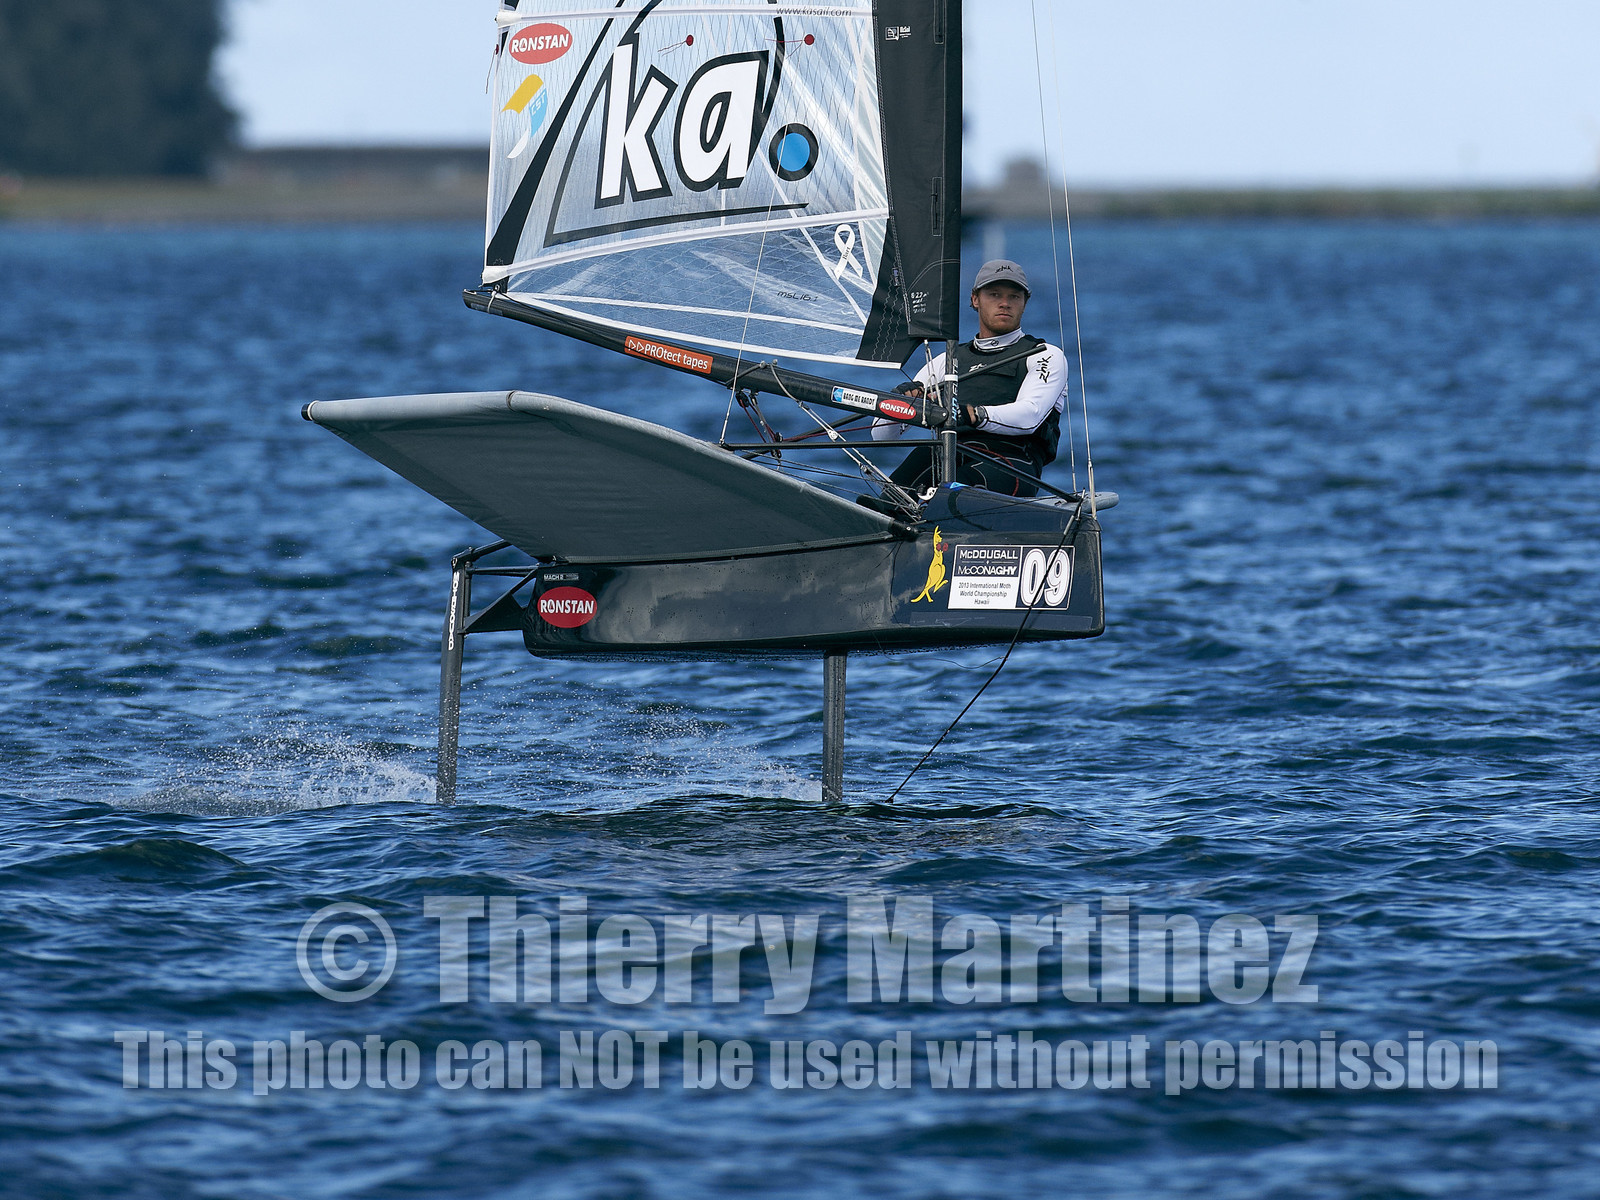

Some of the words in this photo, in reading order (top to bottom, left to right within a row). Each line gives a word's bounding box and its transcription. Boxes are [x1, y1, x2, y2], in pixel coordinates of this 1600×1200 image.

[776, 6, 852, 17] www.kasail.com
[511, 33, 569, 53] RONSTAN
[531, 90, 546, 116] CST
[644, 342, 681, 362] PROtect
[682, 353, 709, 371] tapes
[1037, 355, 1052, 383] zhik
[880, 402, 915, 416] RONSTAN
[959, 549, 1018, 560] McDOUGALL
[958, 566, 1017, 575] McCONAGHY
[1020, 548, 1070, 606] 09
[970, 581, 999, 590] International
[1000, 582, 1012, 590] Moth
[974, 590, 1007, 599] Championship
[540, 599, 594, 614] RONSTAN
